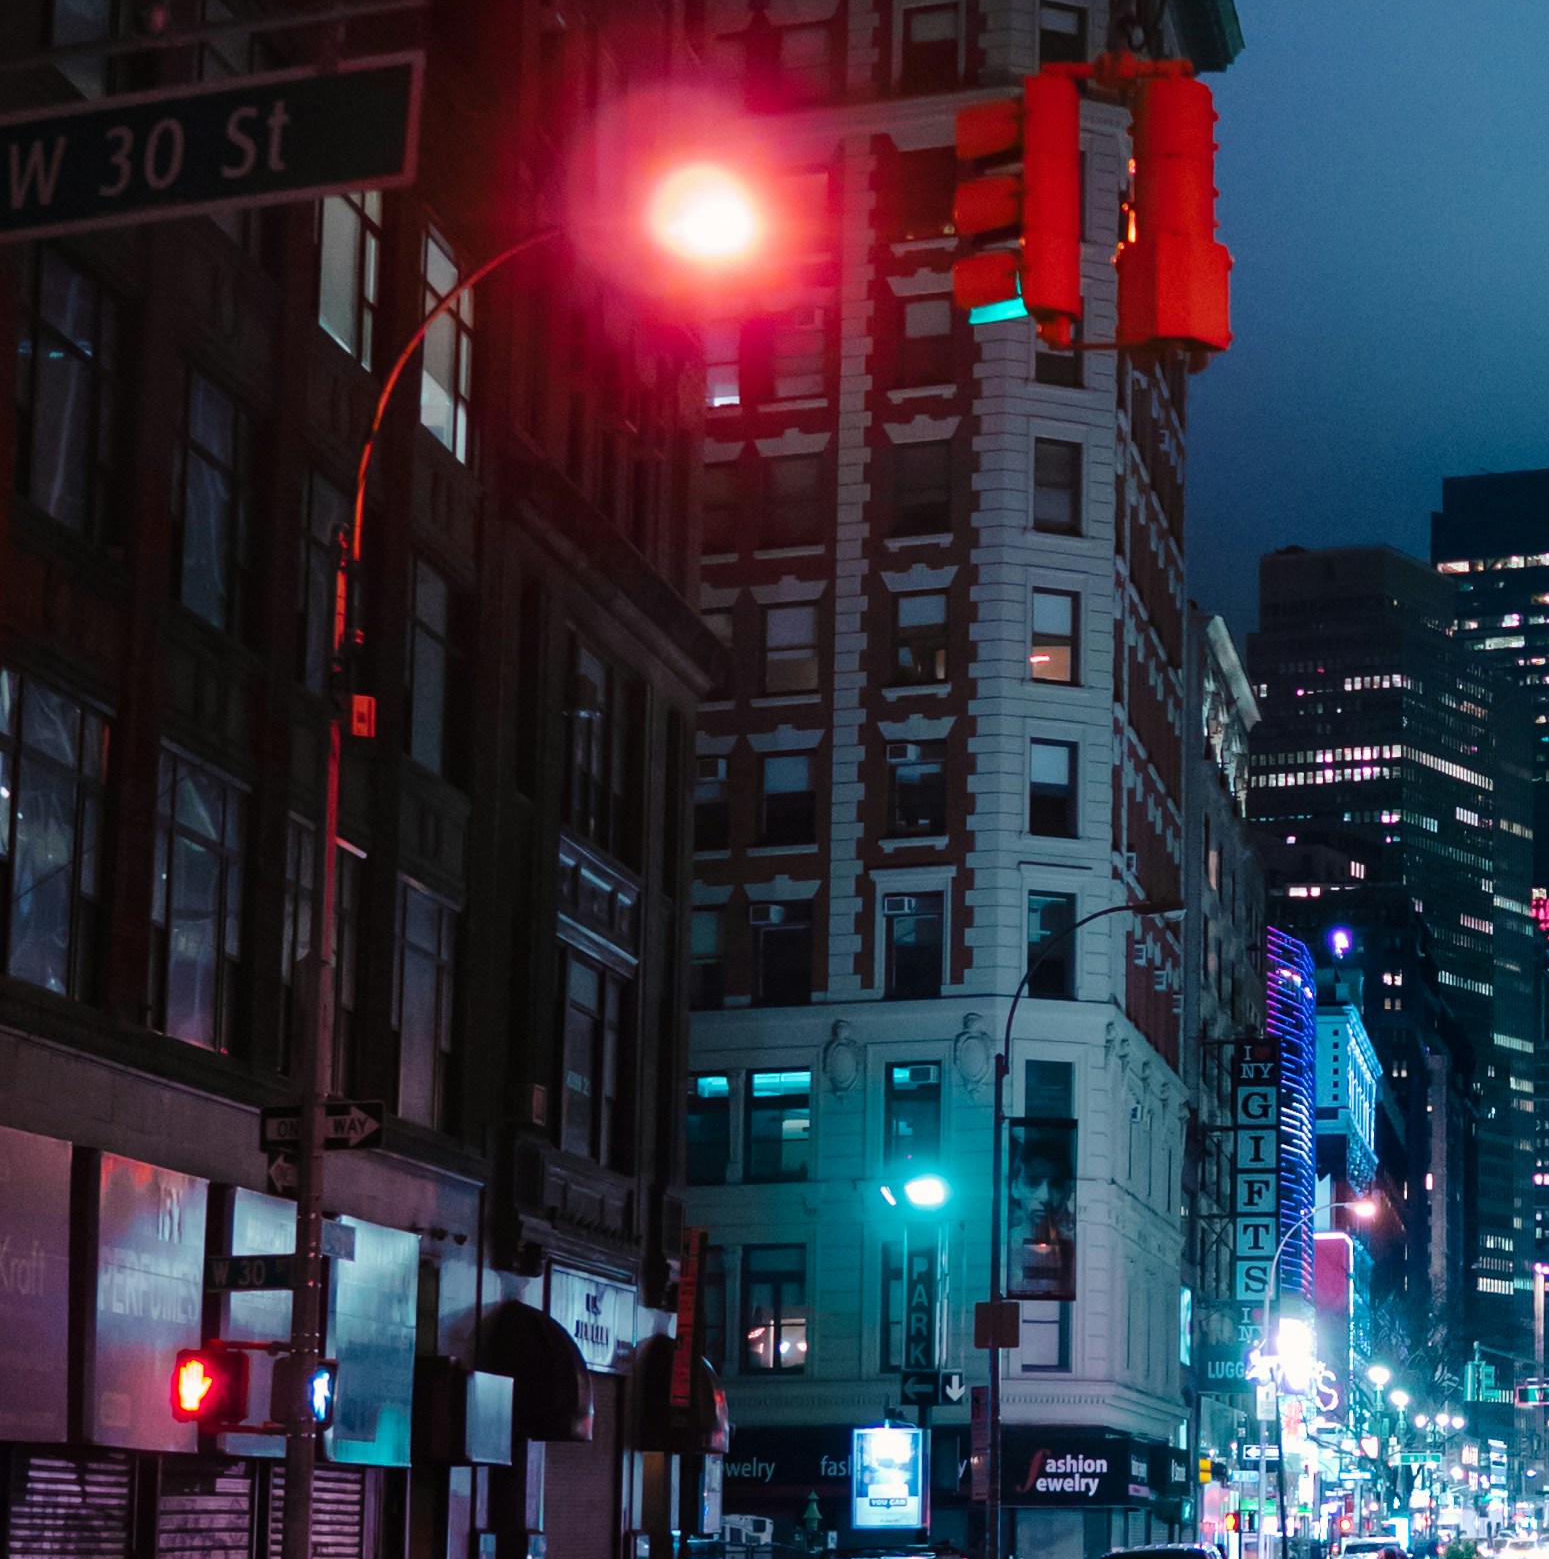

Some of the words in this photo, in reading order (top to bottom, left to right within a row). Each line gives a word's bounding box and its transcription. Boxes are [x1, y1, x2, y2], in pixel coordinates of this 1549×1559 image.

[9, 136, 67, 209] W
[100, 117, 186, 199] 30
[222, 99, 292, 180] St
[1240, 1062, 1275, 1079] NY
[276, 1120, 300, 1138] ON
[332, 1117, 368, 1135] WAY
[1241, 1092, 1273, 1294] GIFTS
[211, 1259, 230, 1286] W
[238, 1258, 267, 1286] 30
[910, 1255, 929, 1367] PARK
[1534, 1389, 1545, 1401] W
[721, 1456, 777, 1483] welry
